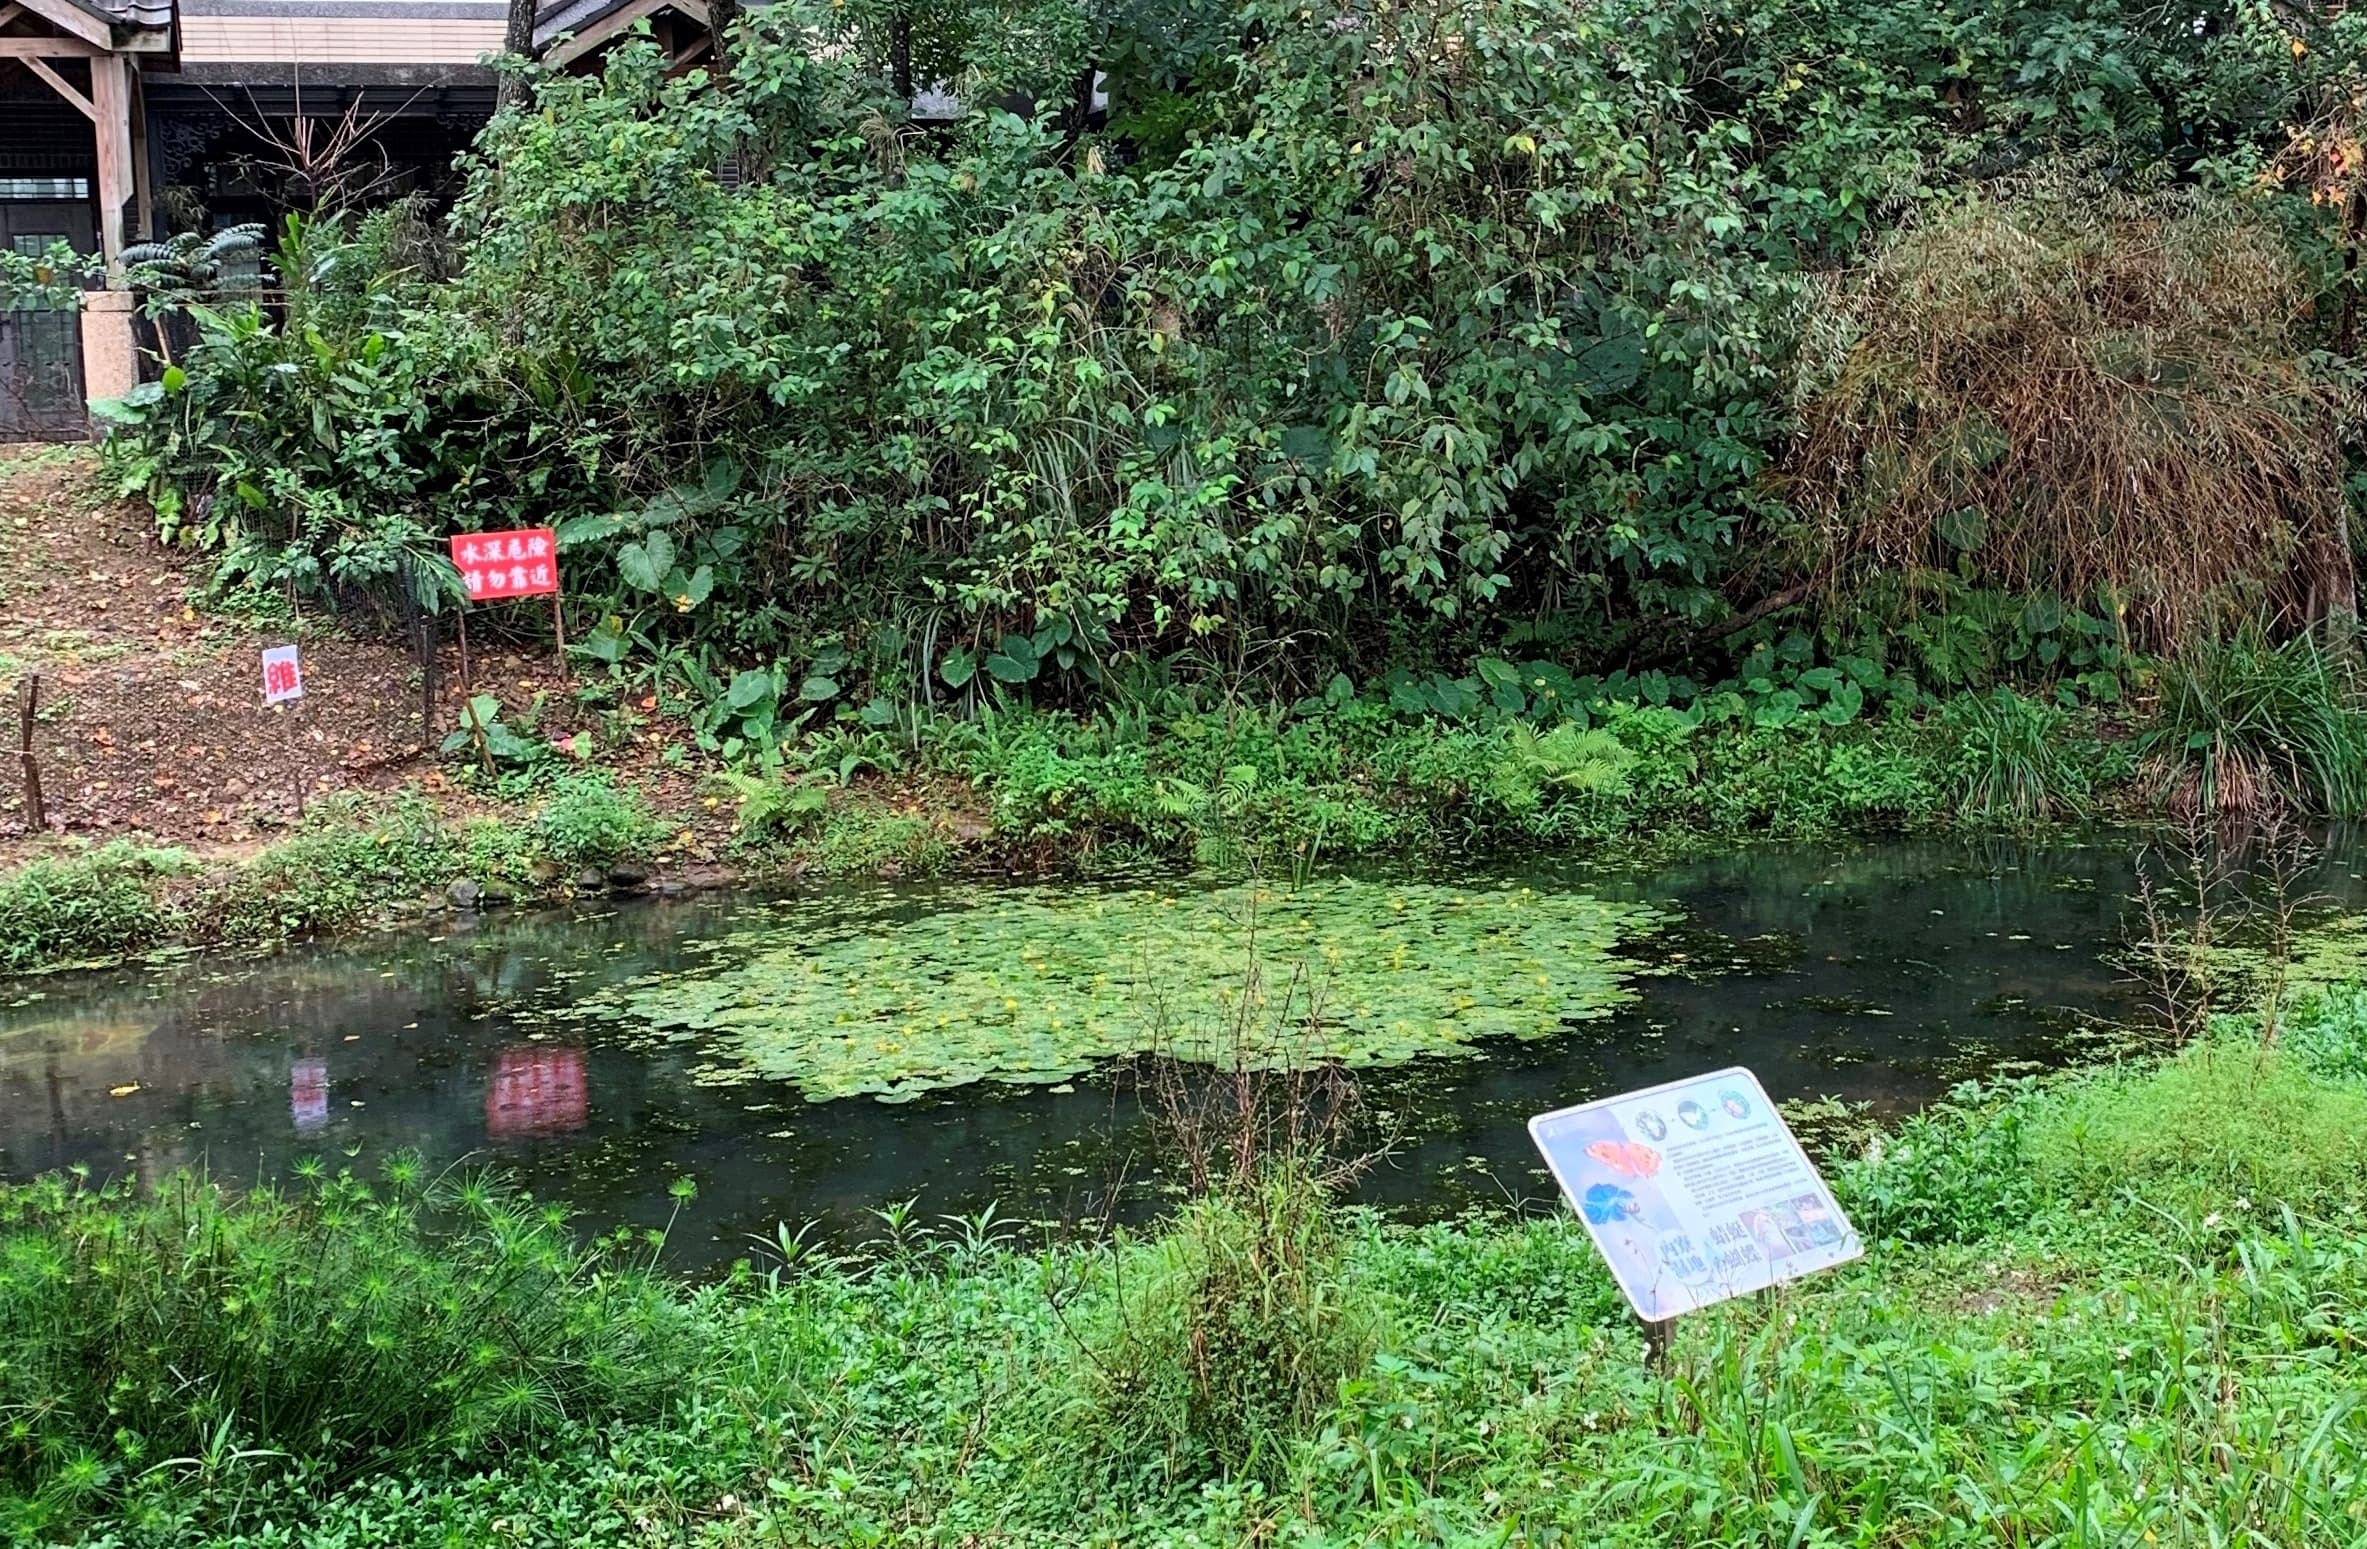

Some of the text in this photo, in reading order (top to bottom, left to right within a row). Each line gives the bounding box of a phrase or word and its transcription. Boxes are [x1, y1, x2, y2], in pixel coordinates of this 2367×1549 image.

[460, 536, 550, 565] 水深危險
[463, 564, 552, 592] 請勿靠近
